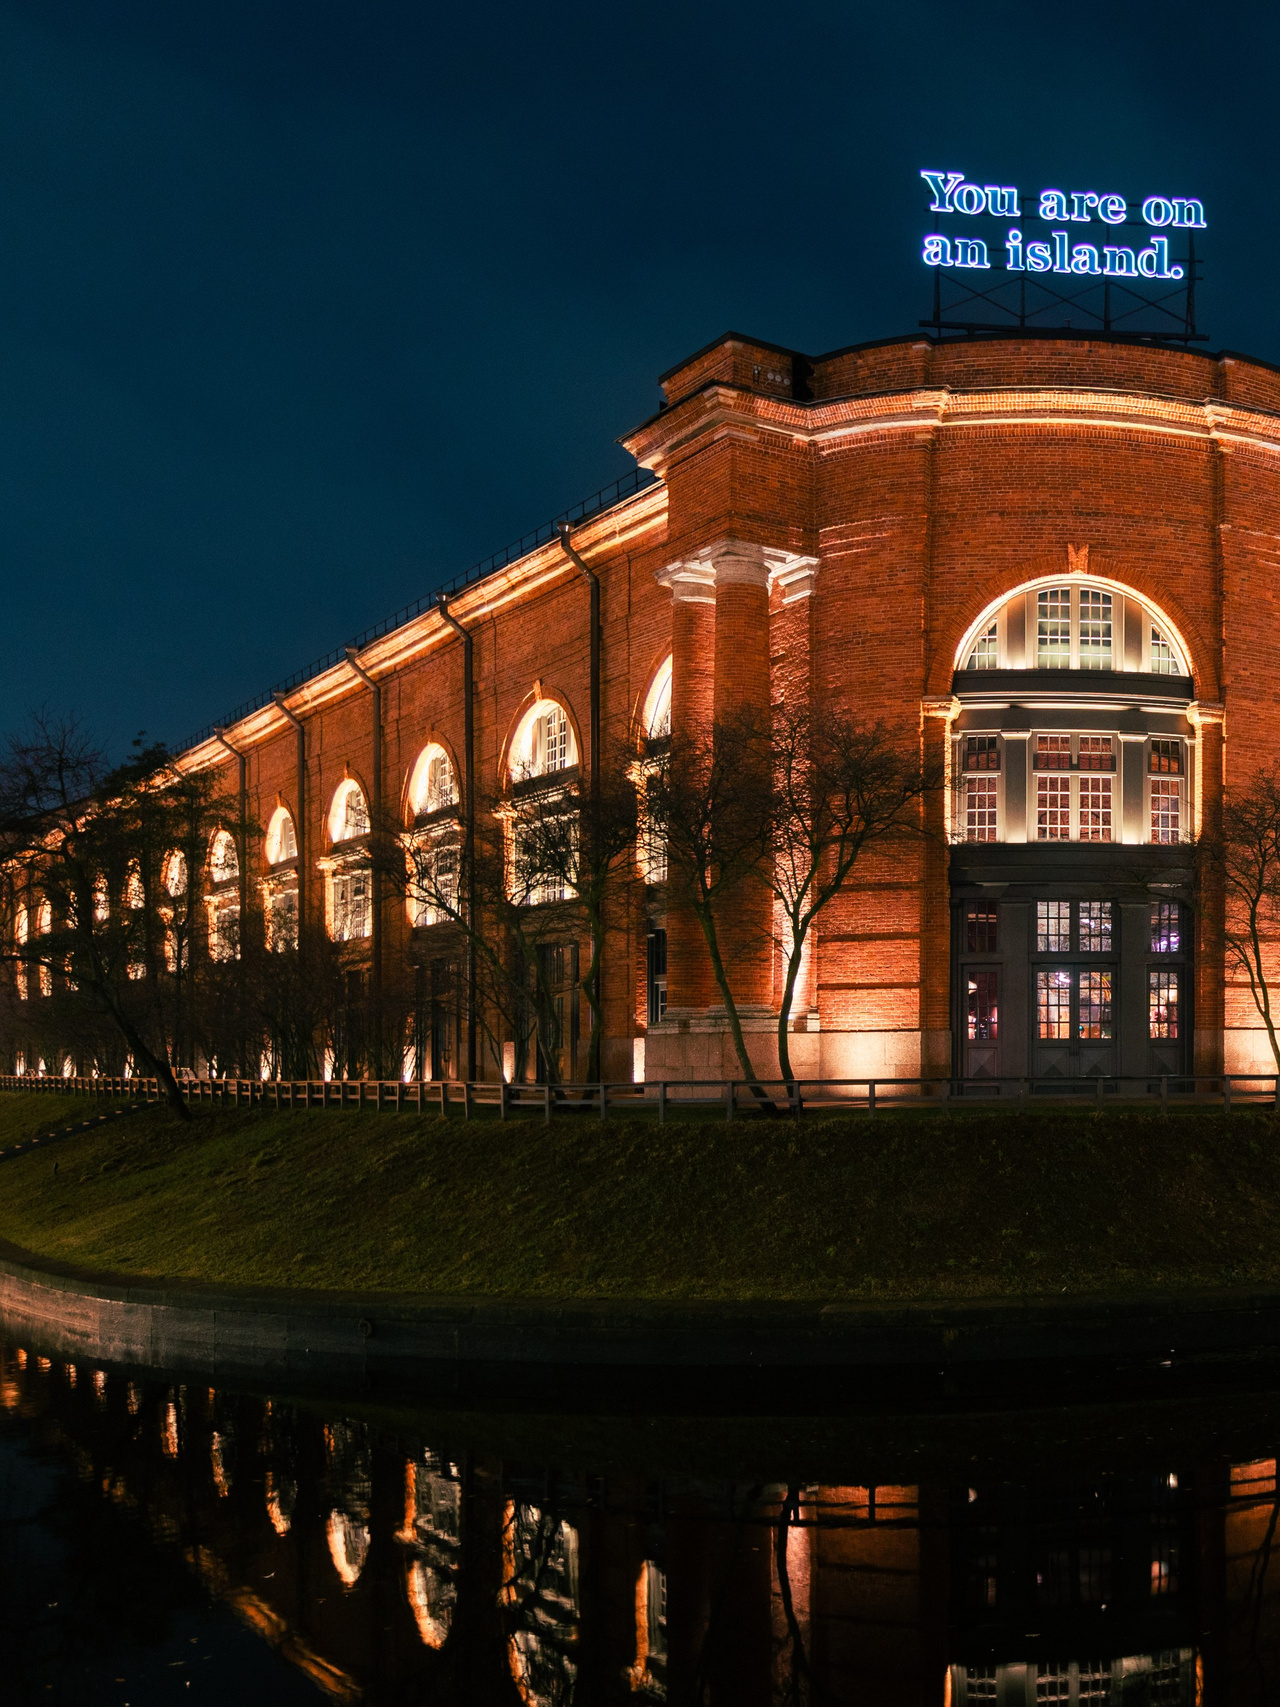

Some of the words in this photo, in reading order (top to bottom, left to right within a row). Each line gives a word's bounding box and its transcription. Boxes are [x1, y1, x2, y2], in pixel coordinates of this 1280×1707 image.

[920, 169, 1021, 217] You
[1039, 188, 1127, 225] are
[1142, 195, 1207, 228] on
[922, 234, 991, 269] an
[1005, 227, 1184, 280] island.
